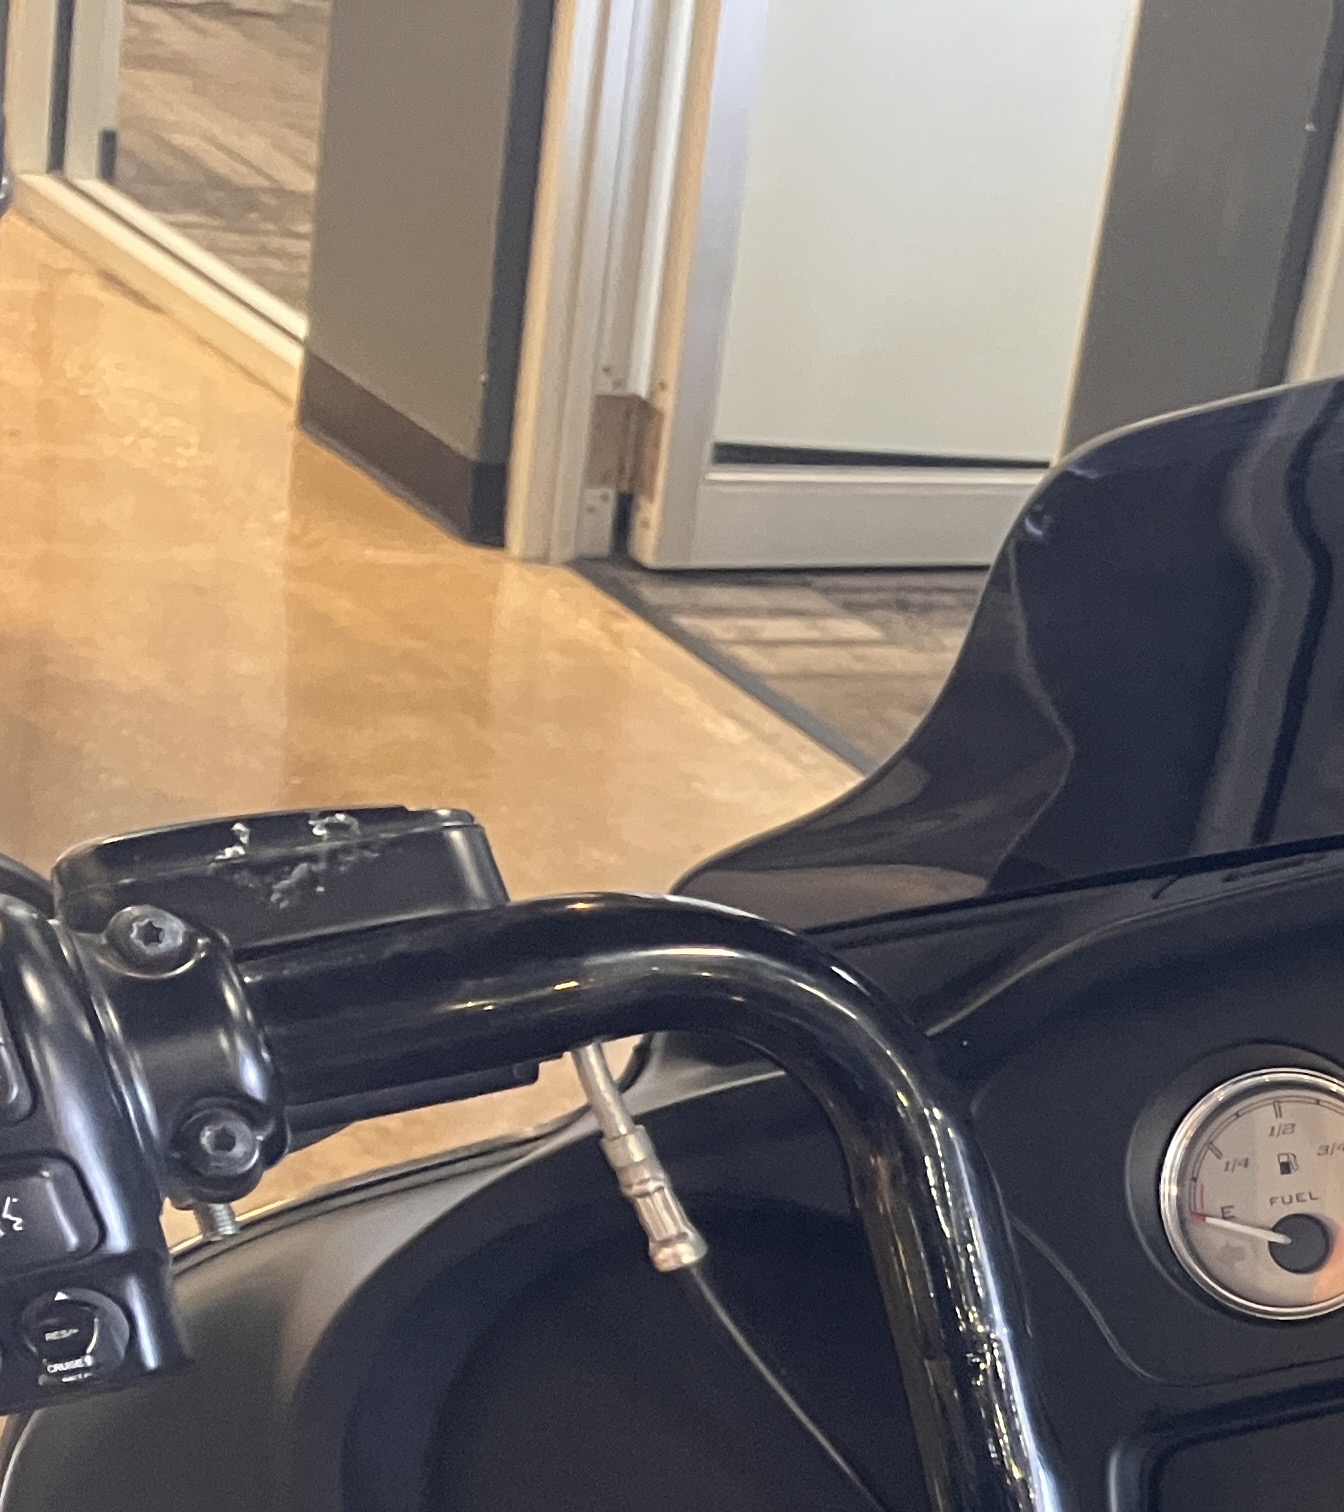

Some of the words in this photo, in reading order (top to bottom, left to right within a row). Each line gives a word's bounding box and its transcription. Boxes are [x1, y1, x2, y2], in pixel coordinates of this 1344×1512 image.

[1268, 1123, 1296, 1138] 1/2
[1224, 1158, 1249, 1172] 1/4
[1269, 1192, 1319, 1206] FUEL
[1221, 1205, 1234, 1219] E
